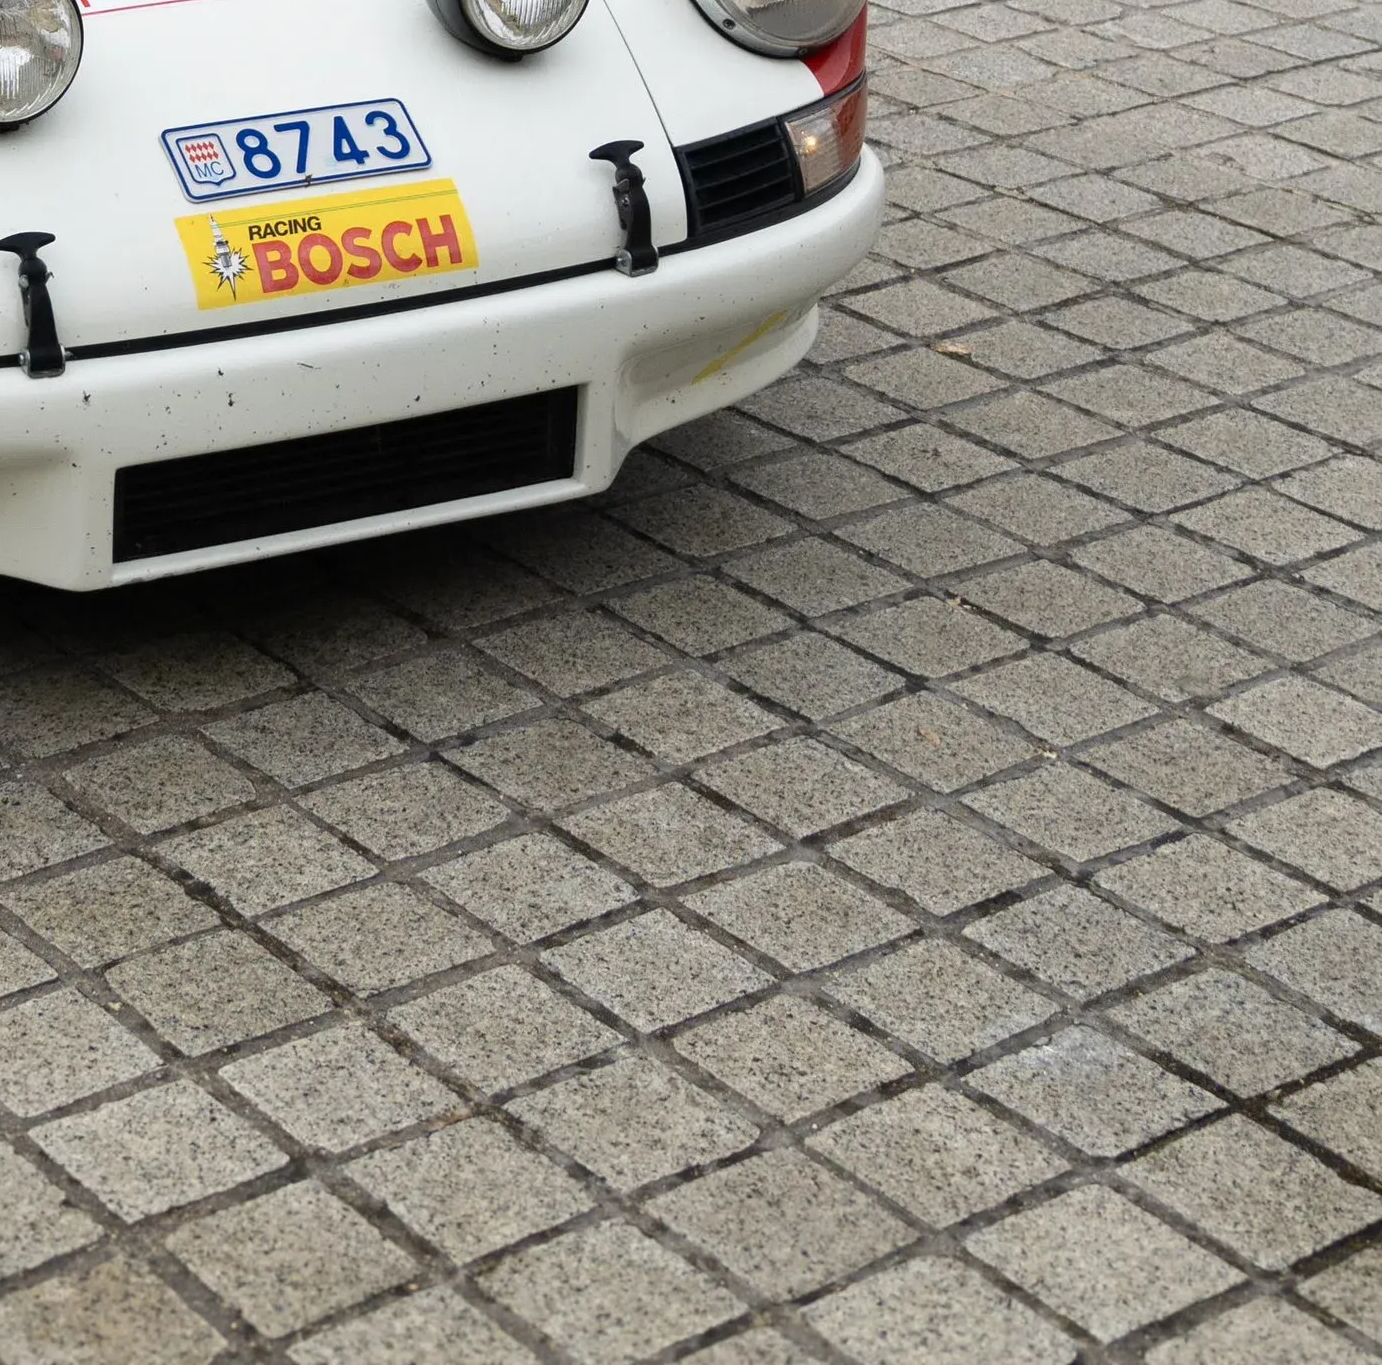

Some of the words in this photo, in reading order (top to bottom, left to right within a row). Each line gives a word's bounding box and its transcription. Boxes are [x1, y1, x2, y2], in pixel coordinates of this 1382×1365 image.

[194, 161, 224, 179] MC
[248, 215, 321, 242] RACING
[251, 214, 462, 294] BOSCH
